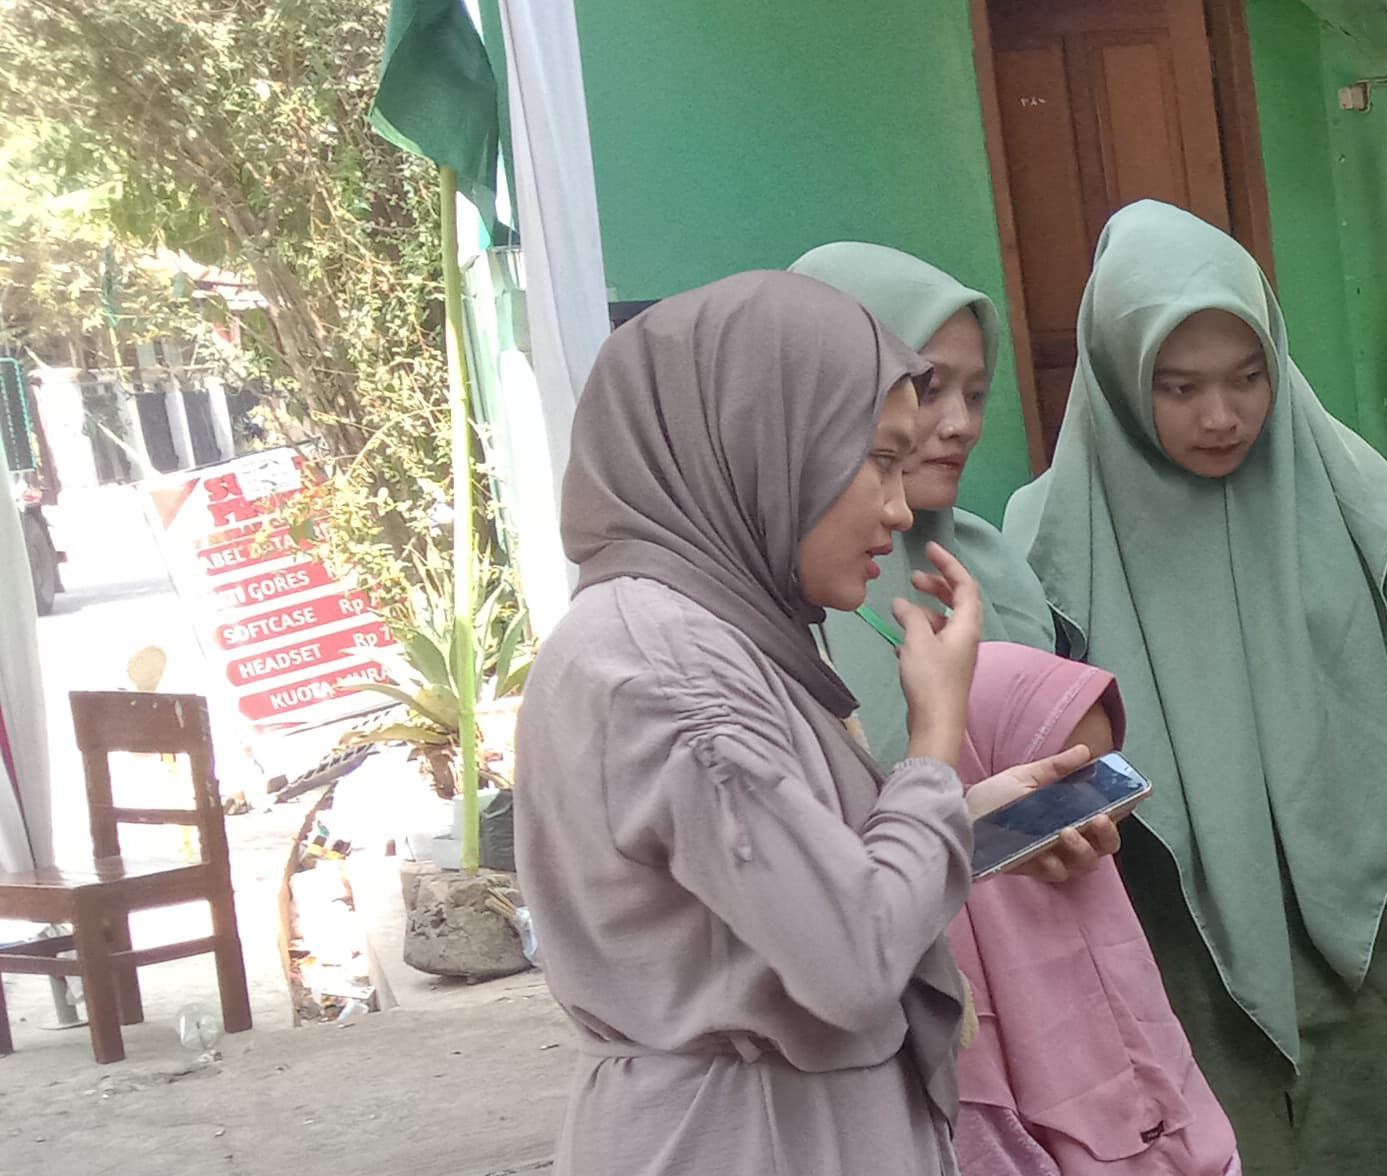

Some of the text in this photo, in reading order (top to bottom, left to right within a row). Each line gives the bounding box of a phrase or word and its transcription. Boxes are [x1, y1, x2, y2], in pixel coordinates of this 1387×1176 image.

[248, 570, 311, 602] GORES
[223, 606, 317, 645] SOFTCASE
[238, 644, 322, 680] HEADSET
